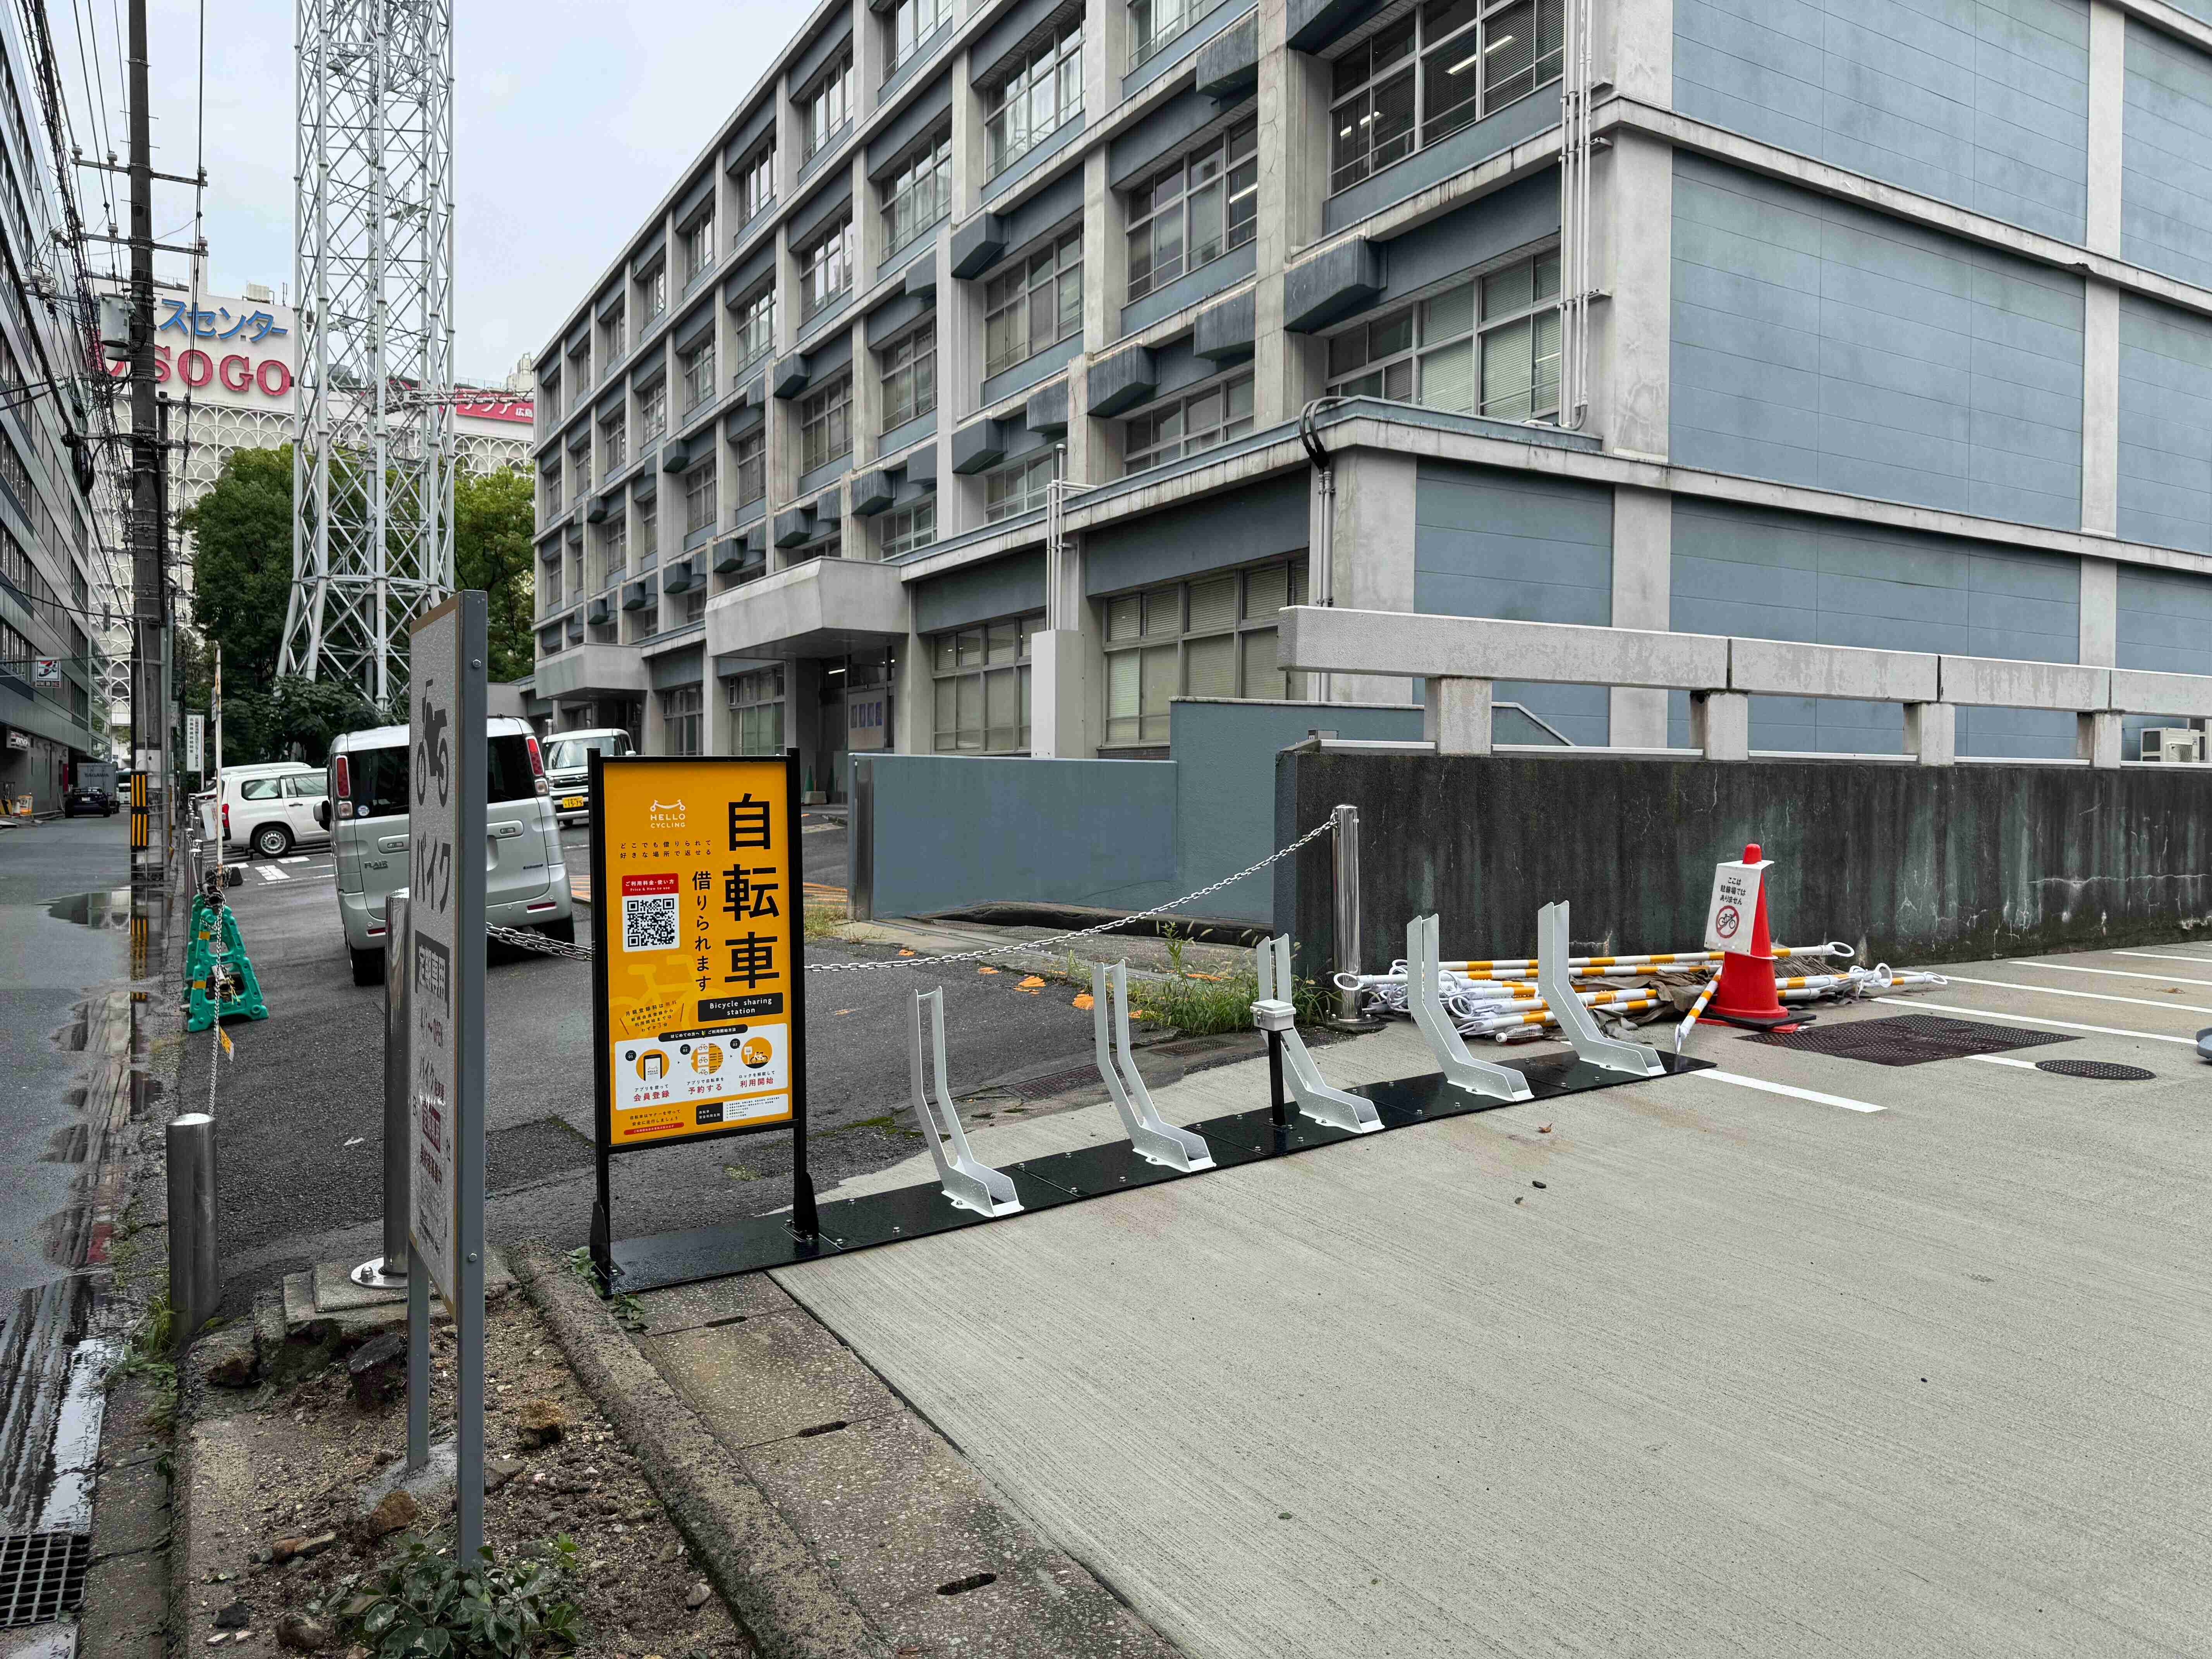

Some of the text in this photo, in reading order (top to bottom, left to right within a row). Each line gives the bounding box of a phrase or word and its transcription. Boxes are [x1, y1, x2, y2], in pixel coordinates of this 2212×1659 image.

[620, 840, 711, 849] どこでも借りられて
[620, 849, 711, 859] 好きな場所で返せる
[415, 830, 451, 914] バイク
[1728, 877, 1741, 886] ここは
[722, 793, 780, 989] 自転車
[1720, 884, 1746, 896] 駐輪場では
[1719, 895, 1742, 905] ありません
[692, 871, 713, 991] 借りられます
[709, 997, 772, 1010] Bicycle sharing
[727, 1007, 756, 1015] station
[635, 1084, 669, 1092] アプリを使って
[740, 1077, 773, 1088] 利用開始
[688, 1084, 722, 1095] 予約する
[633, 1090, 670, 1102] 会員登録
